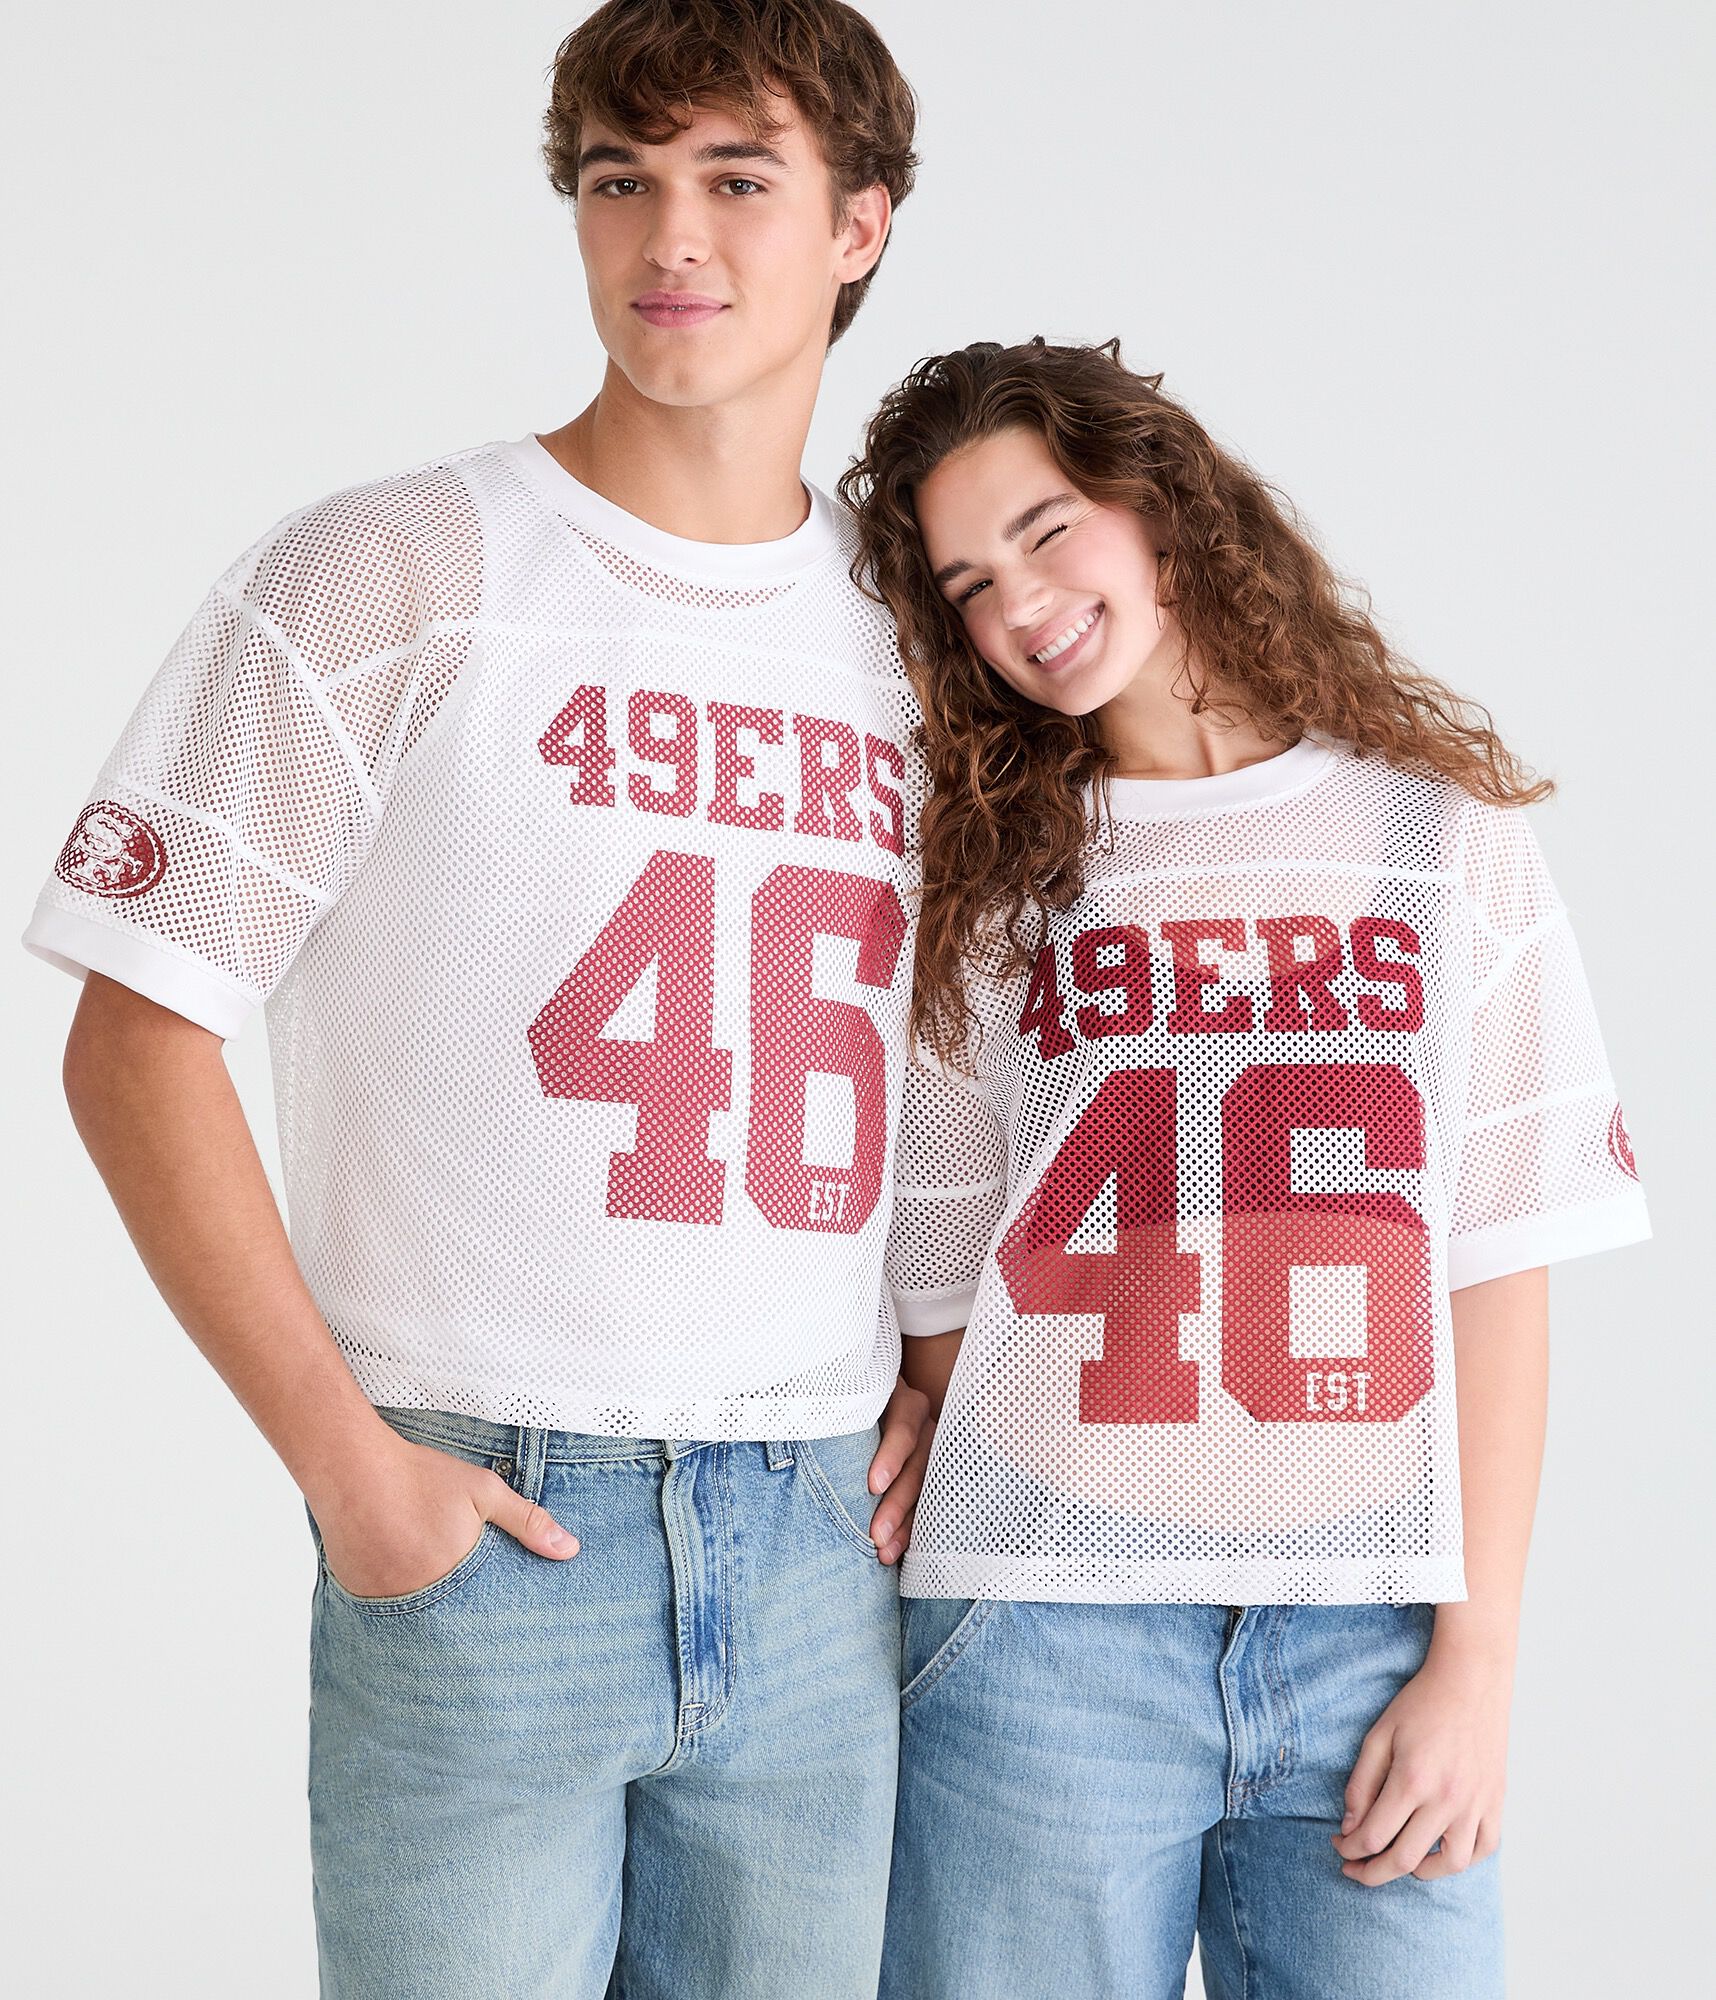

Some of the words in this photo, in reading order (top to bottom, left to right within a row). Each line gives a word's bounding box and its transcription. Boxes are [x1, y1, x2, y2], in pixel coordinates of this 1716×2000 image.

[537, 684, 906, 858] 49ERS
[526, 849, 908, 1236] 46
[1018, 915, 1426, 1062] 49ERS
[808, 1179, 849, 1223] EST
[995, 1063, 1435, 1425] 46
[1305, 1370, 1371, 1413] EST
